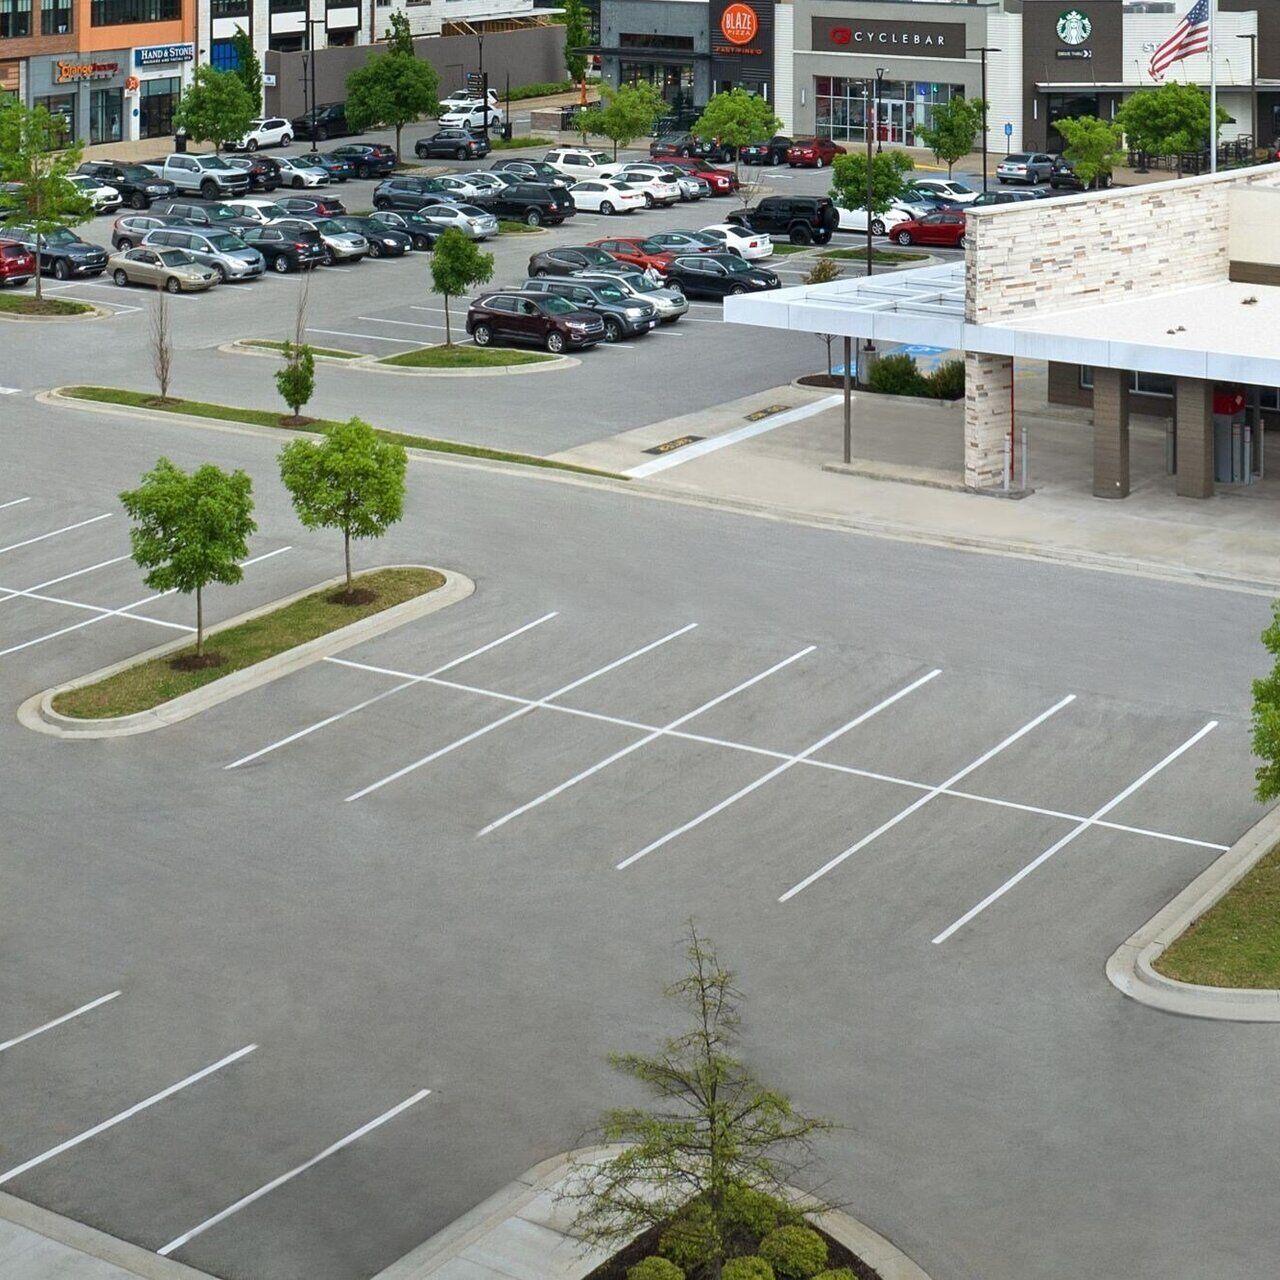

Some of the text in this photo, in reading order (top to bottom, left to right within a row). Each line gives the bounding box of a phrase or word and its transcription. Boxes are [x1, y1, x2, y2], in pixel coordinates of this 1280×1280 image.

[725, 11, 752, 30] BLAZE
[854, 31, 945, 46] CYCLEBAR
[140, 48, 164, 61] HAND
[169, 44, 194, 57] STONE
